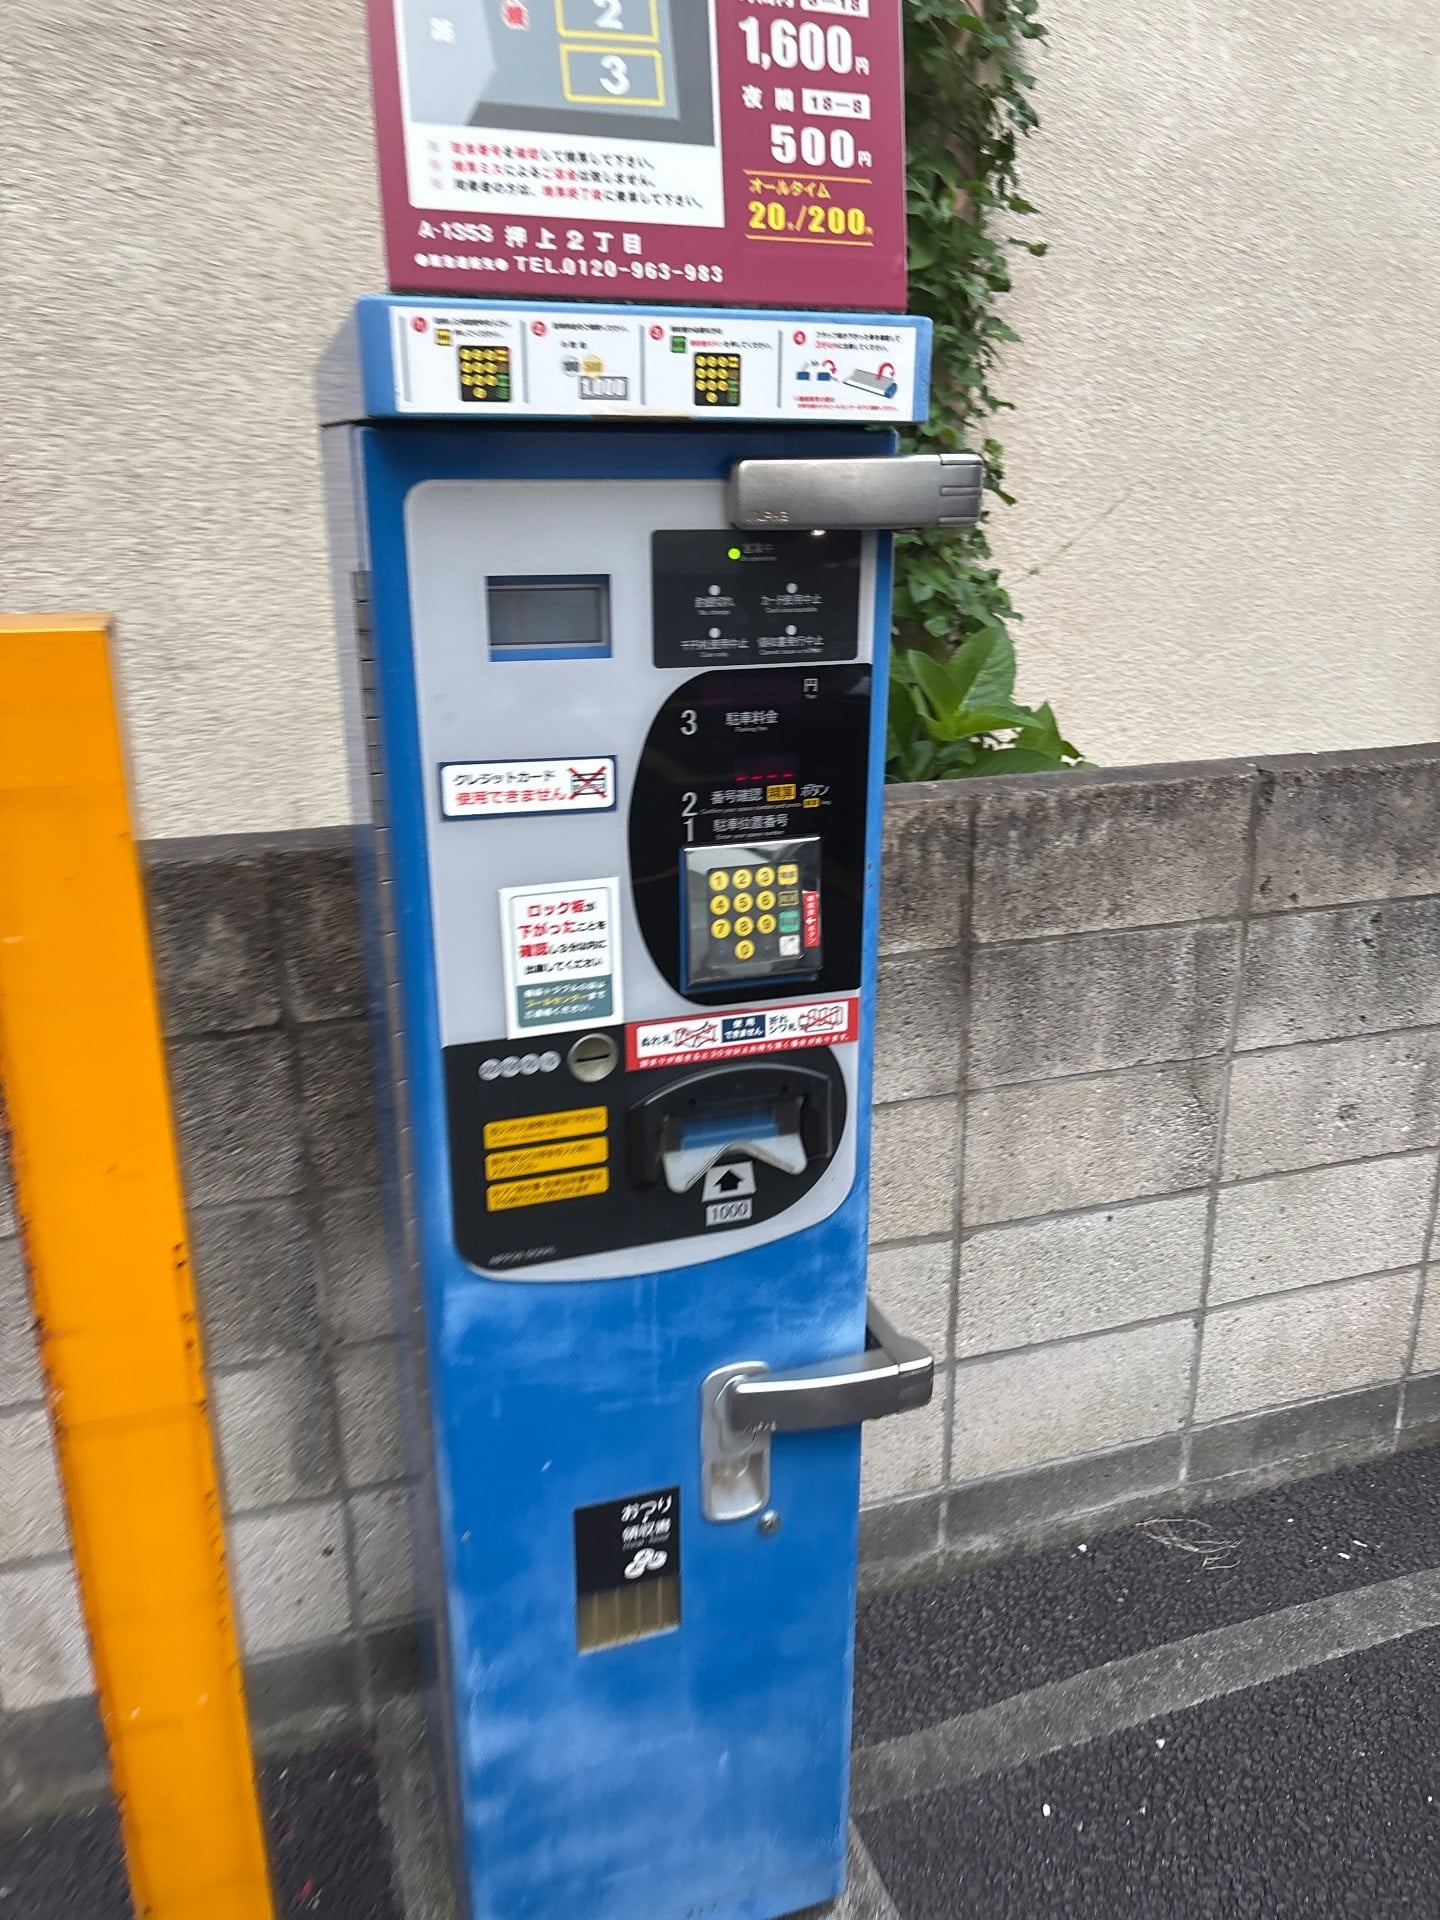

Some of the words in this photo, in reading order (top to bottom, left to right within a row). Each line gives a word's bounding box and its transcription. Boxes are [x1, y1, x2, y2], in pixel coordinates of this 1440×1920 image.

[593, 0, 625, 30] 2
[600, 54, 630, 95] 3
[749, 177, 832, 199] オールタイム
[803, 678, 818, 692] 円
[680, 709, 697, 735] 3
[725, 709, 779, 727] 駐車料金
[453, 770, 556, 786] クレジットカード
[456, 788, 567, 806] 使用できません
[681, 791, 698, 817] 2
[683, 817, 694, 842] 1
[724, 1027, 763, 1040] できません
[712, 1202, 748, 1221] 1000
[621, 1495, 672, 1523] おつり
